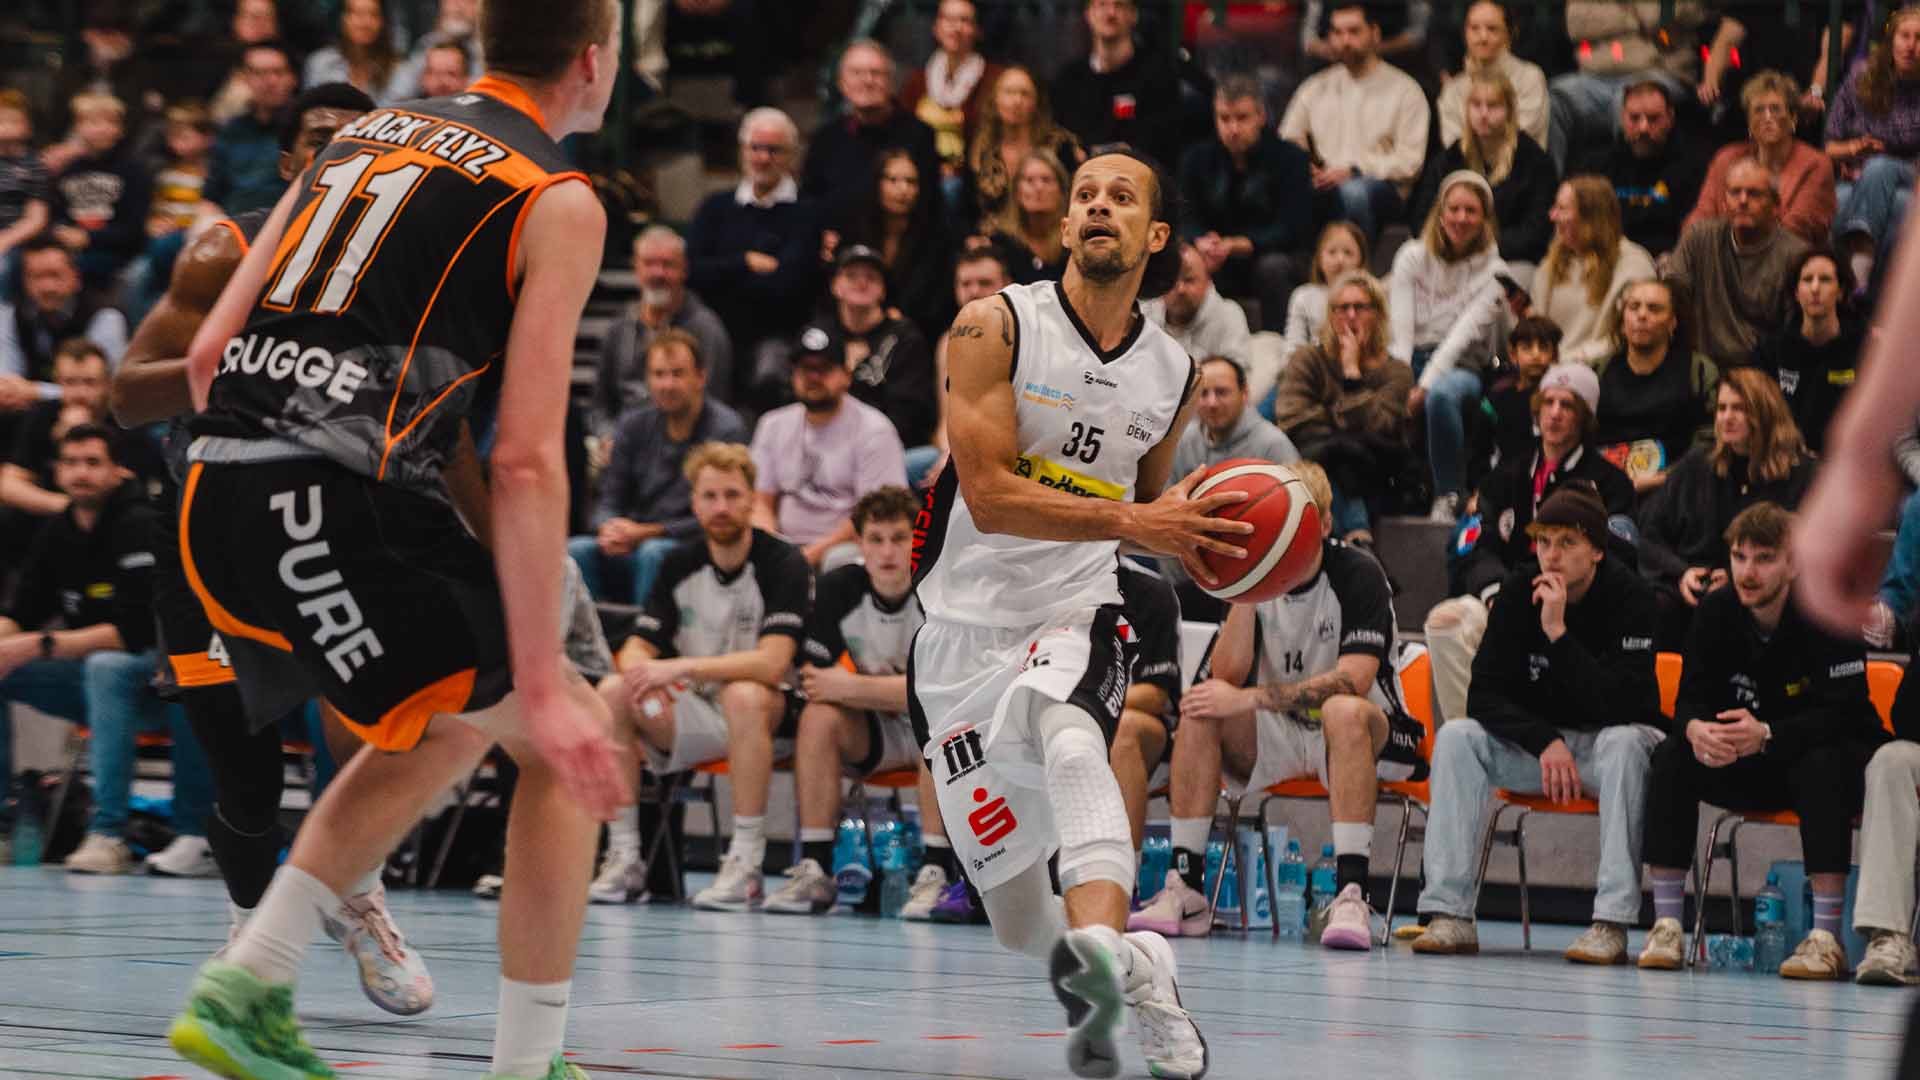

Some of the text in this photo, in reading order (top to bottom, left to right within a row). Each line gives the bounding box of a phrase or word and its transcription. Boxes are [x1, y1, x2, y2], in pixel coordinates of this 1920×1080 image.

[334, 112, 507, 177] LACK FLYZ
[269, 153, 425, 313] 11
[215, 333, 369, 404] RUGGE
[1061, 421, 1104, 464] 35
[1126, 424, 1153, 443] DENT
[269, 485, 385, 684] PURE
[208, 632, 232, 668] 4
[1284, 650, 1304, 674] 14
[943, 729, 984, 777] fit
